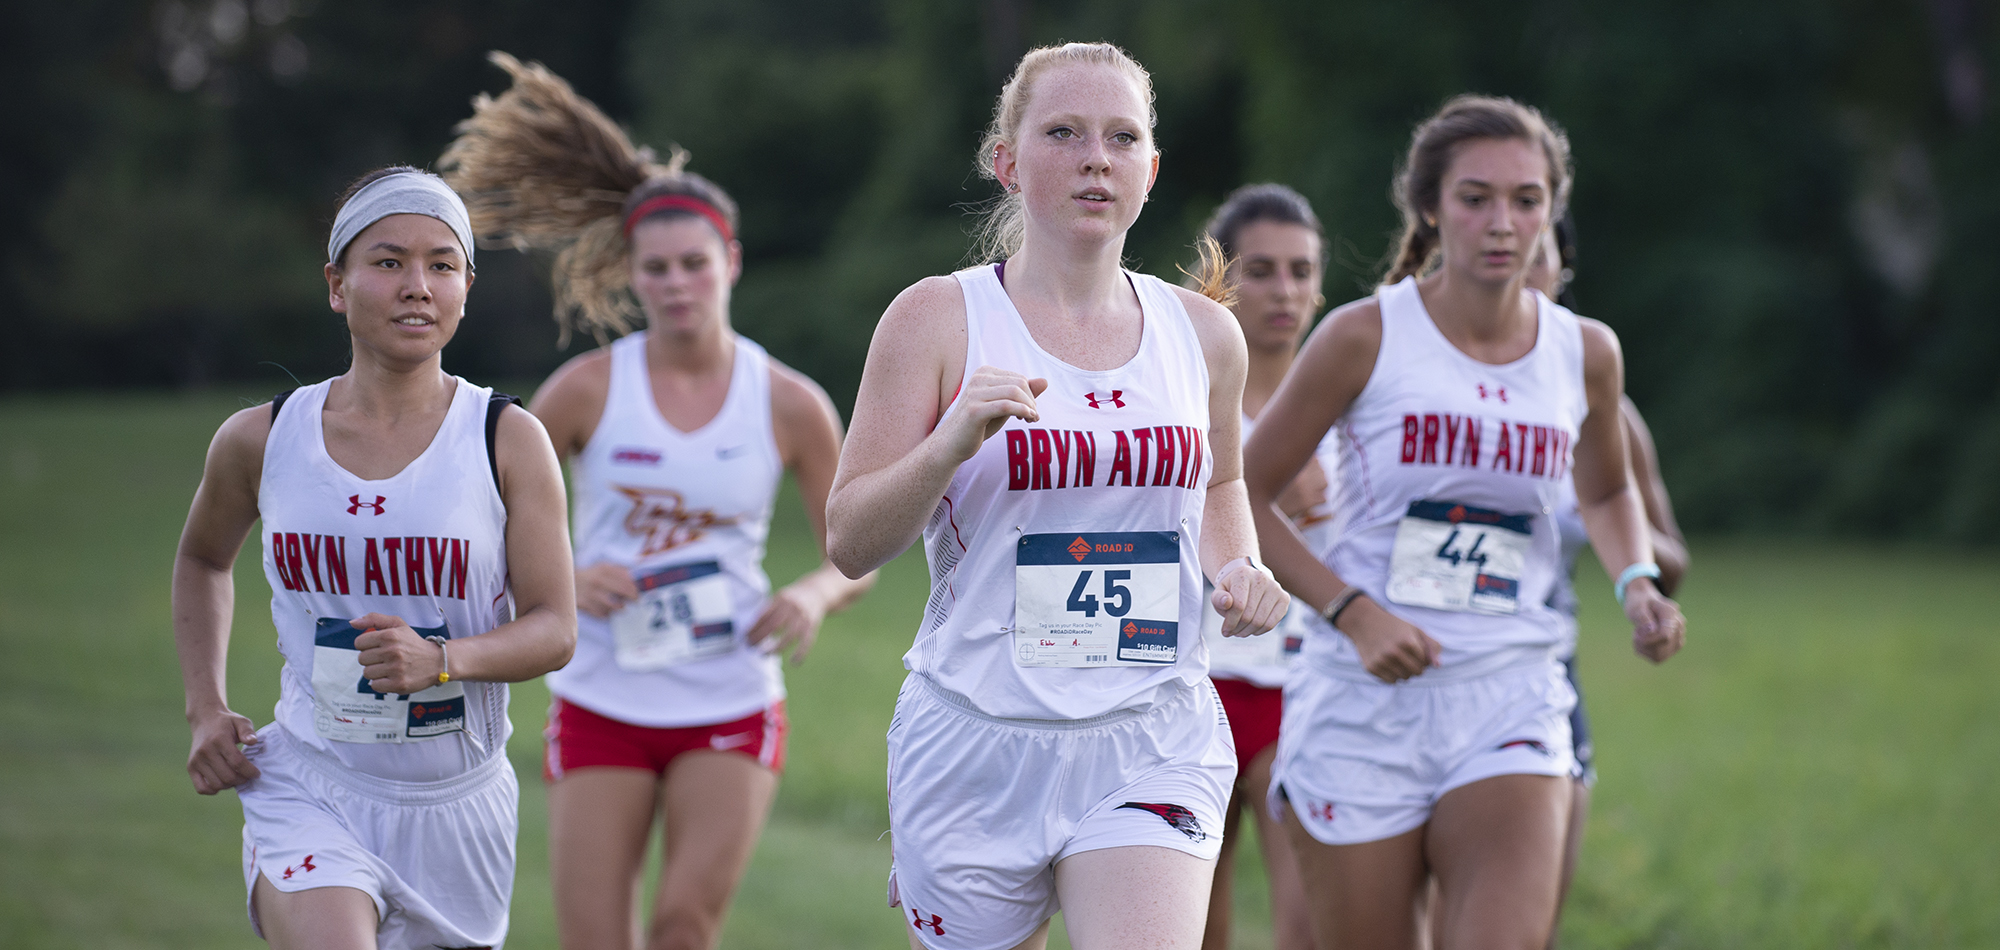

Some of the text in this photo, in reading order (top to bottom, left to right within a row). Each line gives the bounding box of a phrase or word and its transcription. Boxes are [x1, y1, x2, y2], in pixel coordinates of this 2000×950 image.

[1005, 425, 1204, 491] BRYN ATHYN
[1401, 413, 1481, 468] BRYN
[272, 532, 470, 600] BRYN ATHYN
[1095, 543, 1122, 553] ROAD
[1437, 530, 1487, 567] 44
[647, 592, 692, 630] 28
[1066, 569, 1132, 618] 45
[1137, 643, 1149, 651] $10
[1140, 627, 1158, 635] ROAD
